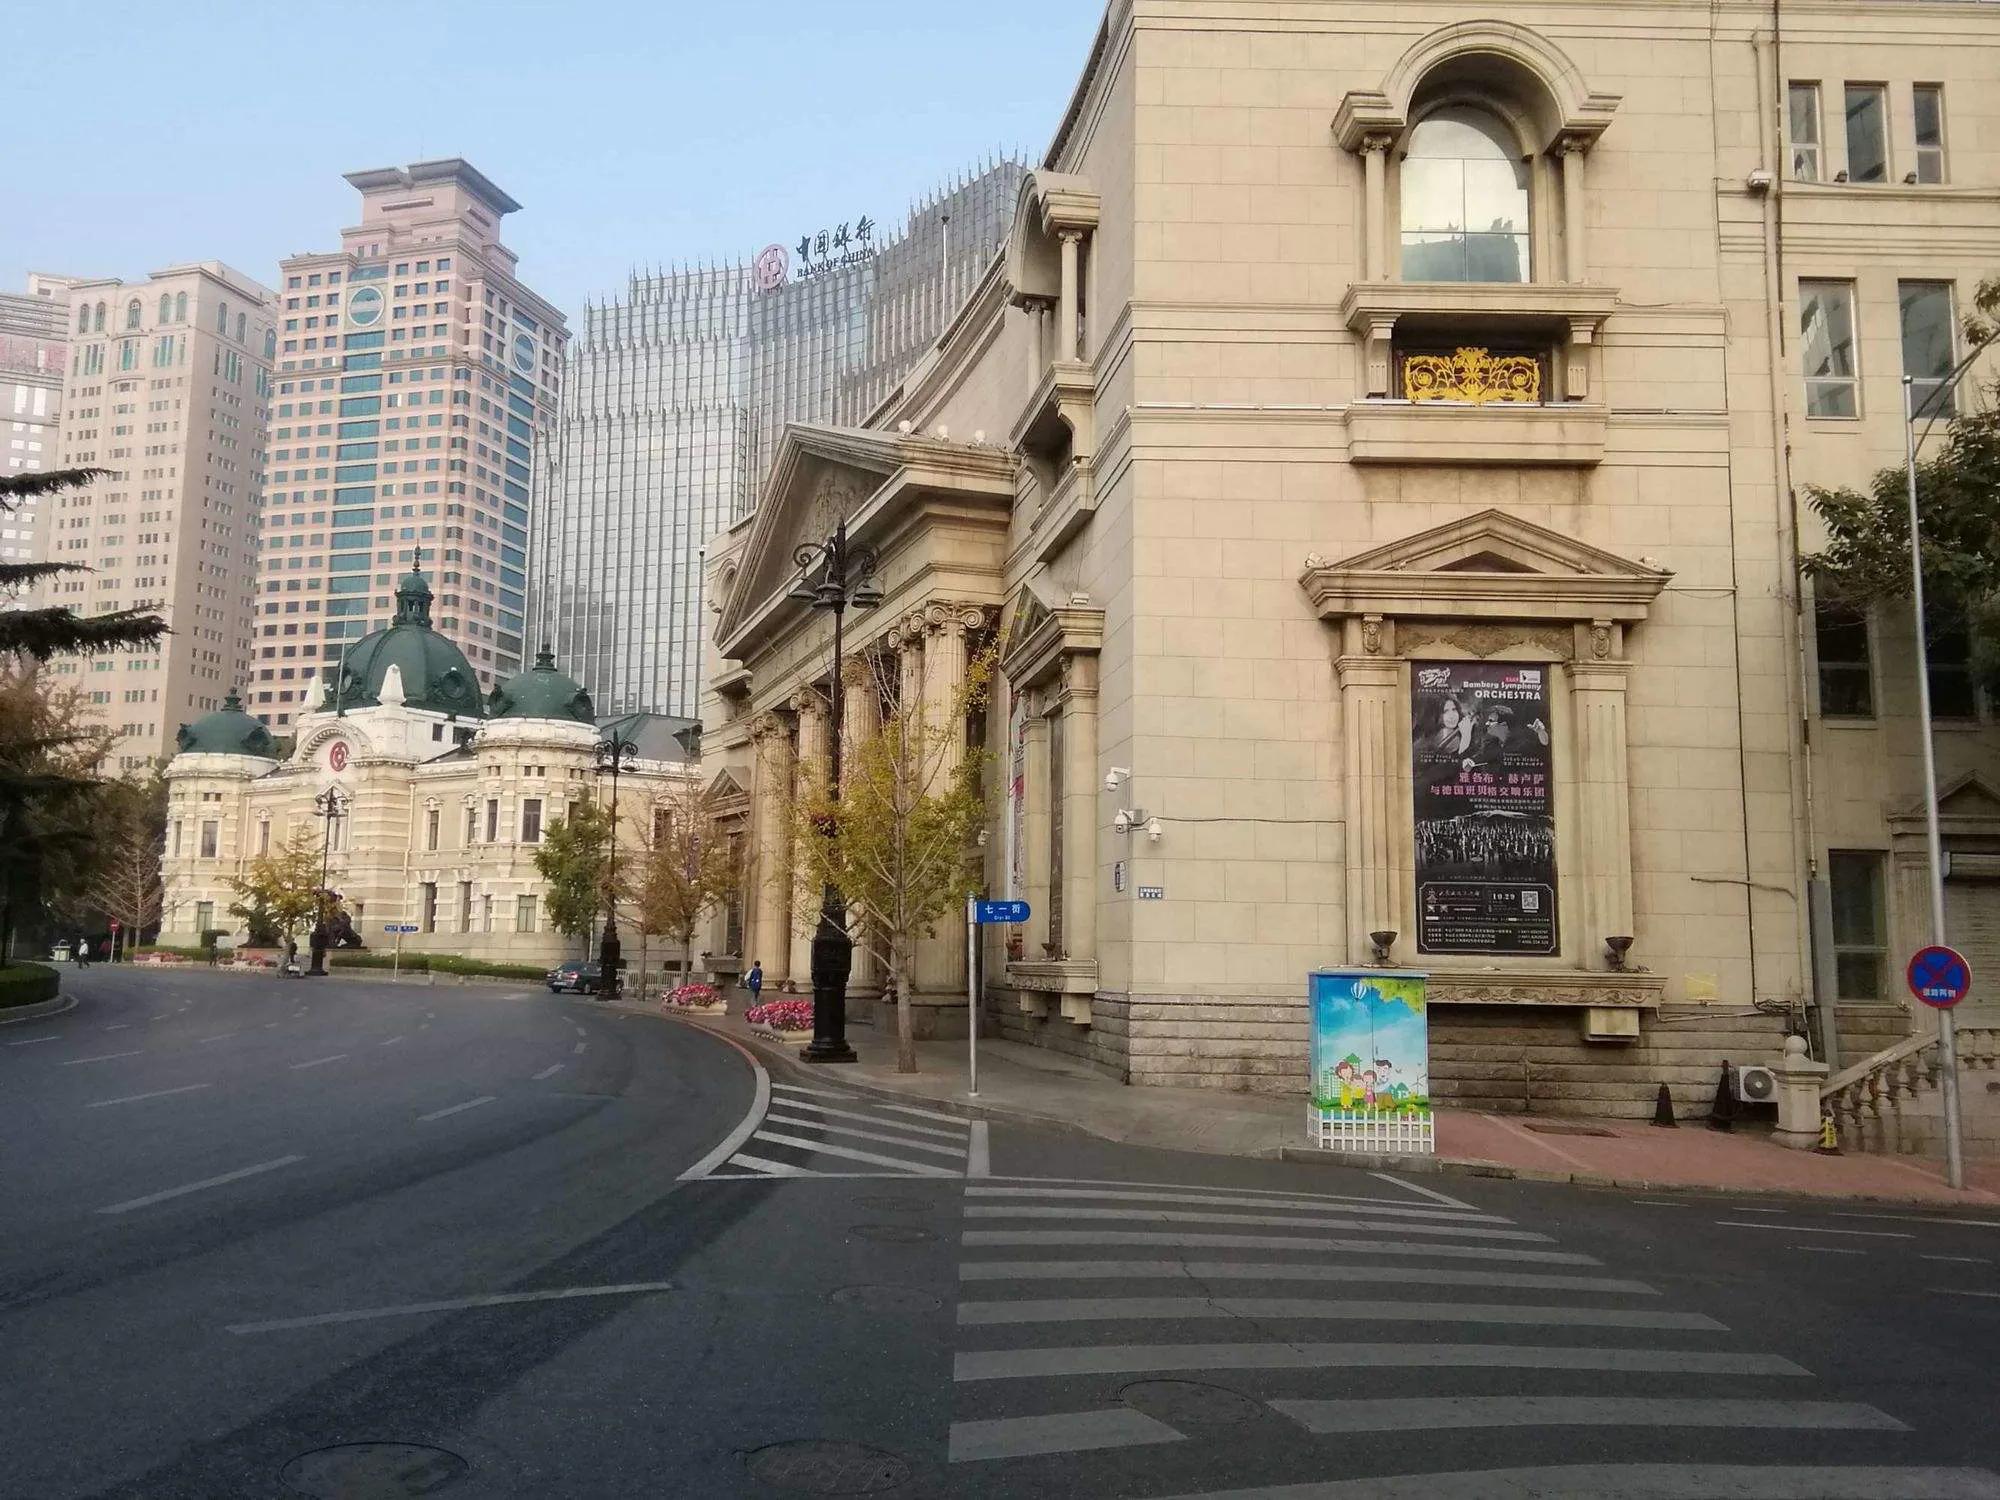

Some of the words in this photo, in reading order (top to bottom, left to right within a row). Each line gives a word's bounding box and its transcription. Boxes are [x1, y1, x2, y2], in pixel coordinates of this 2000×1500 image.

[796, 215, 875, 262] 中国银行
[797, 260, 825, 278] BANK
[826, 258, 838, 271] OF
[841, 247, 874, 264] CHINA
[1463, 681, 1499, 689] Bamberg
[1501, 681, 1541, 691] Symphony
[1474, 689, 1541, 700] ORCHESTRA
[985, 904, 1020, 914] 七一街
